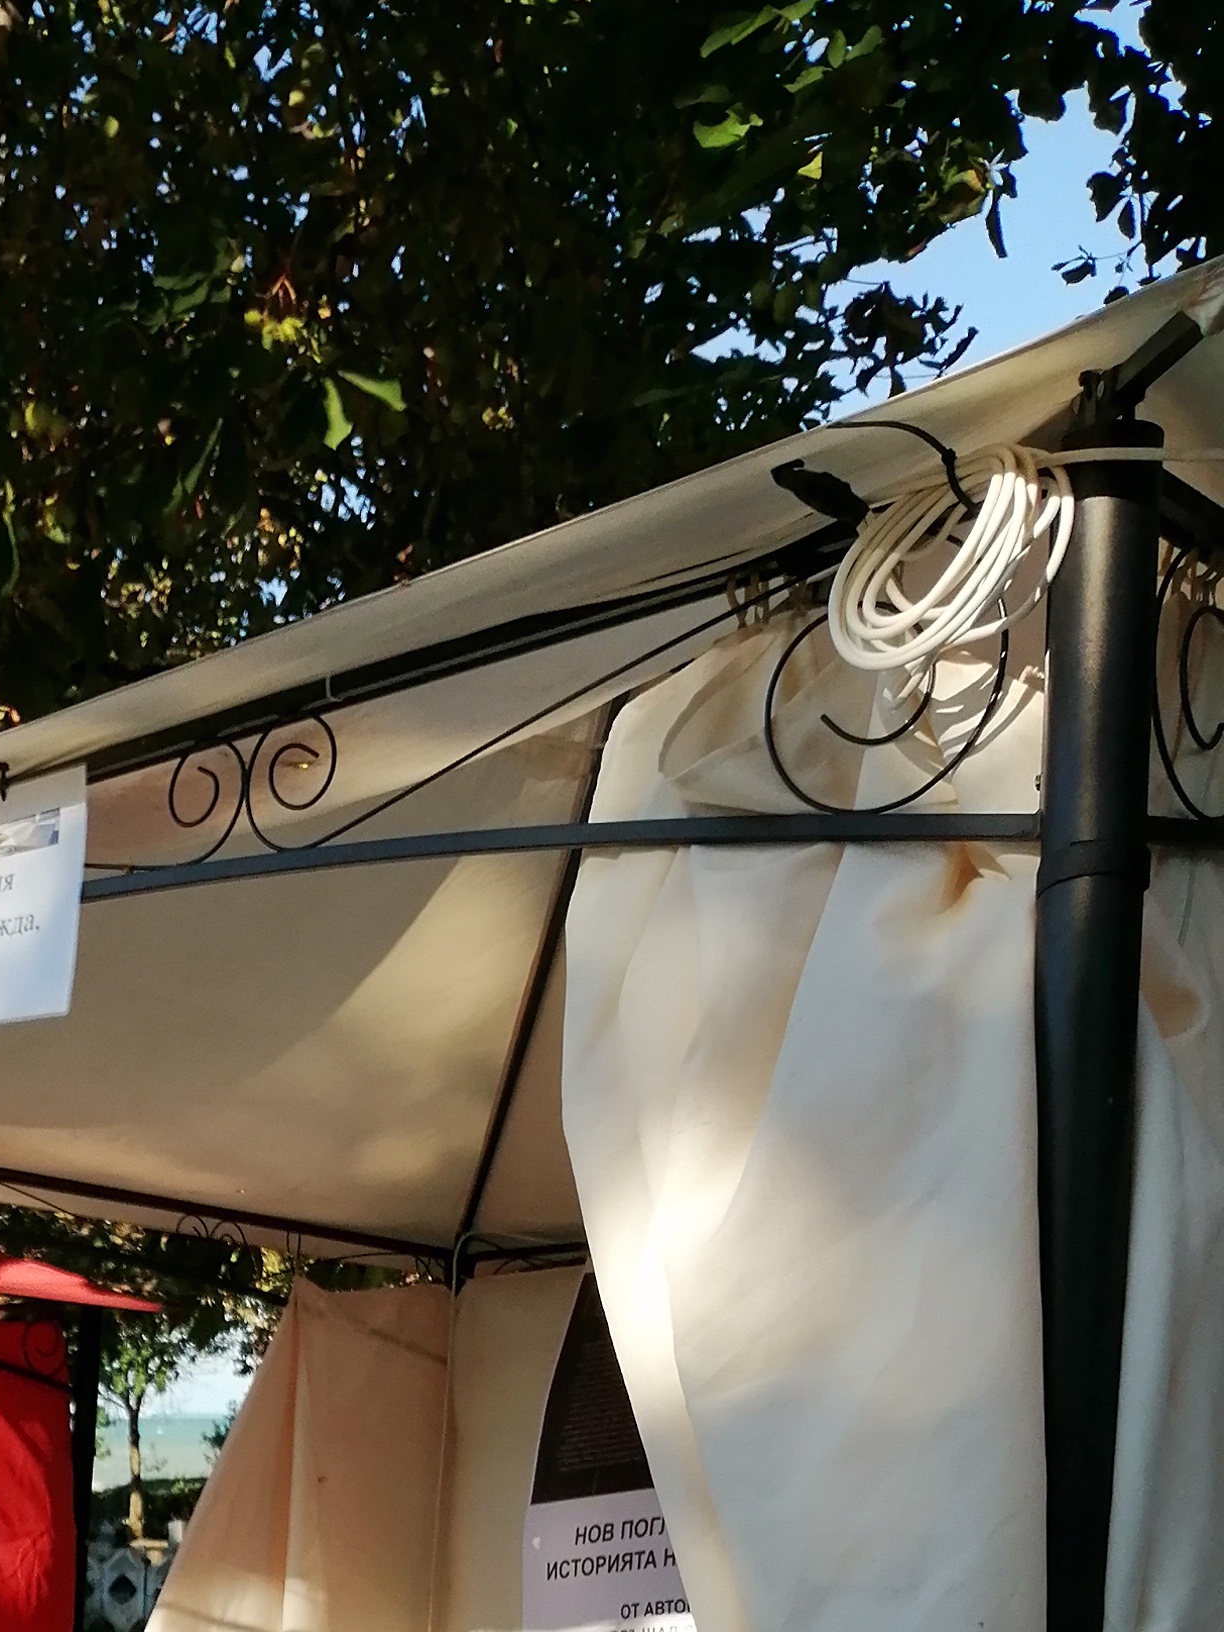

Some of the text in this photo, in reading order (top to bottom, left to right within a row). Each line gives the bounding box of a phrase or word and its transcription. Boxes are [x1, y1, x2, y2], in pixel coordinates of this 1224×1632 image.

[575, 1522, 614, 1546] НОВ
[546, 1549, 657, 1581] ИСТОРИЯТА
[620, 1598, 691, 1620] ОТ АВТО
